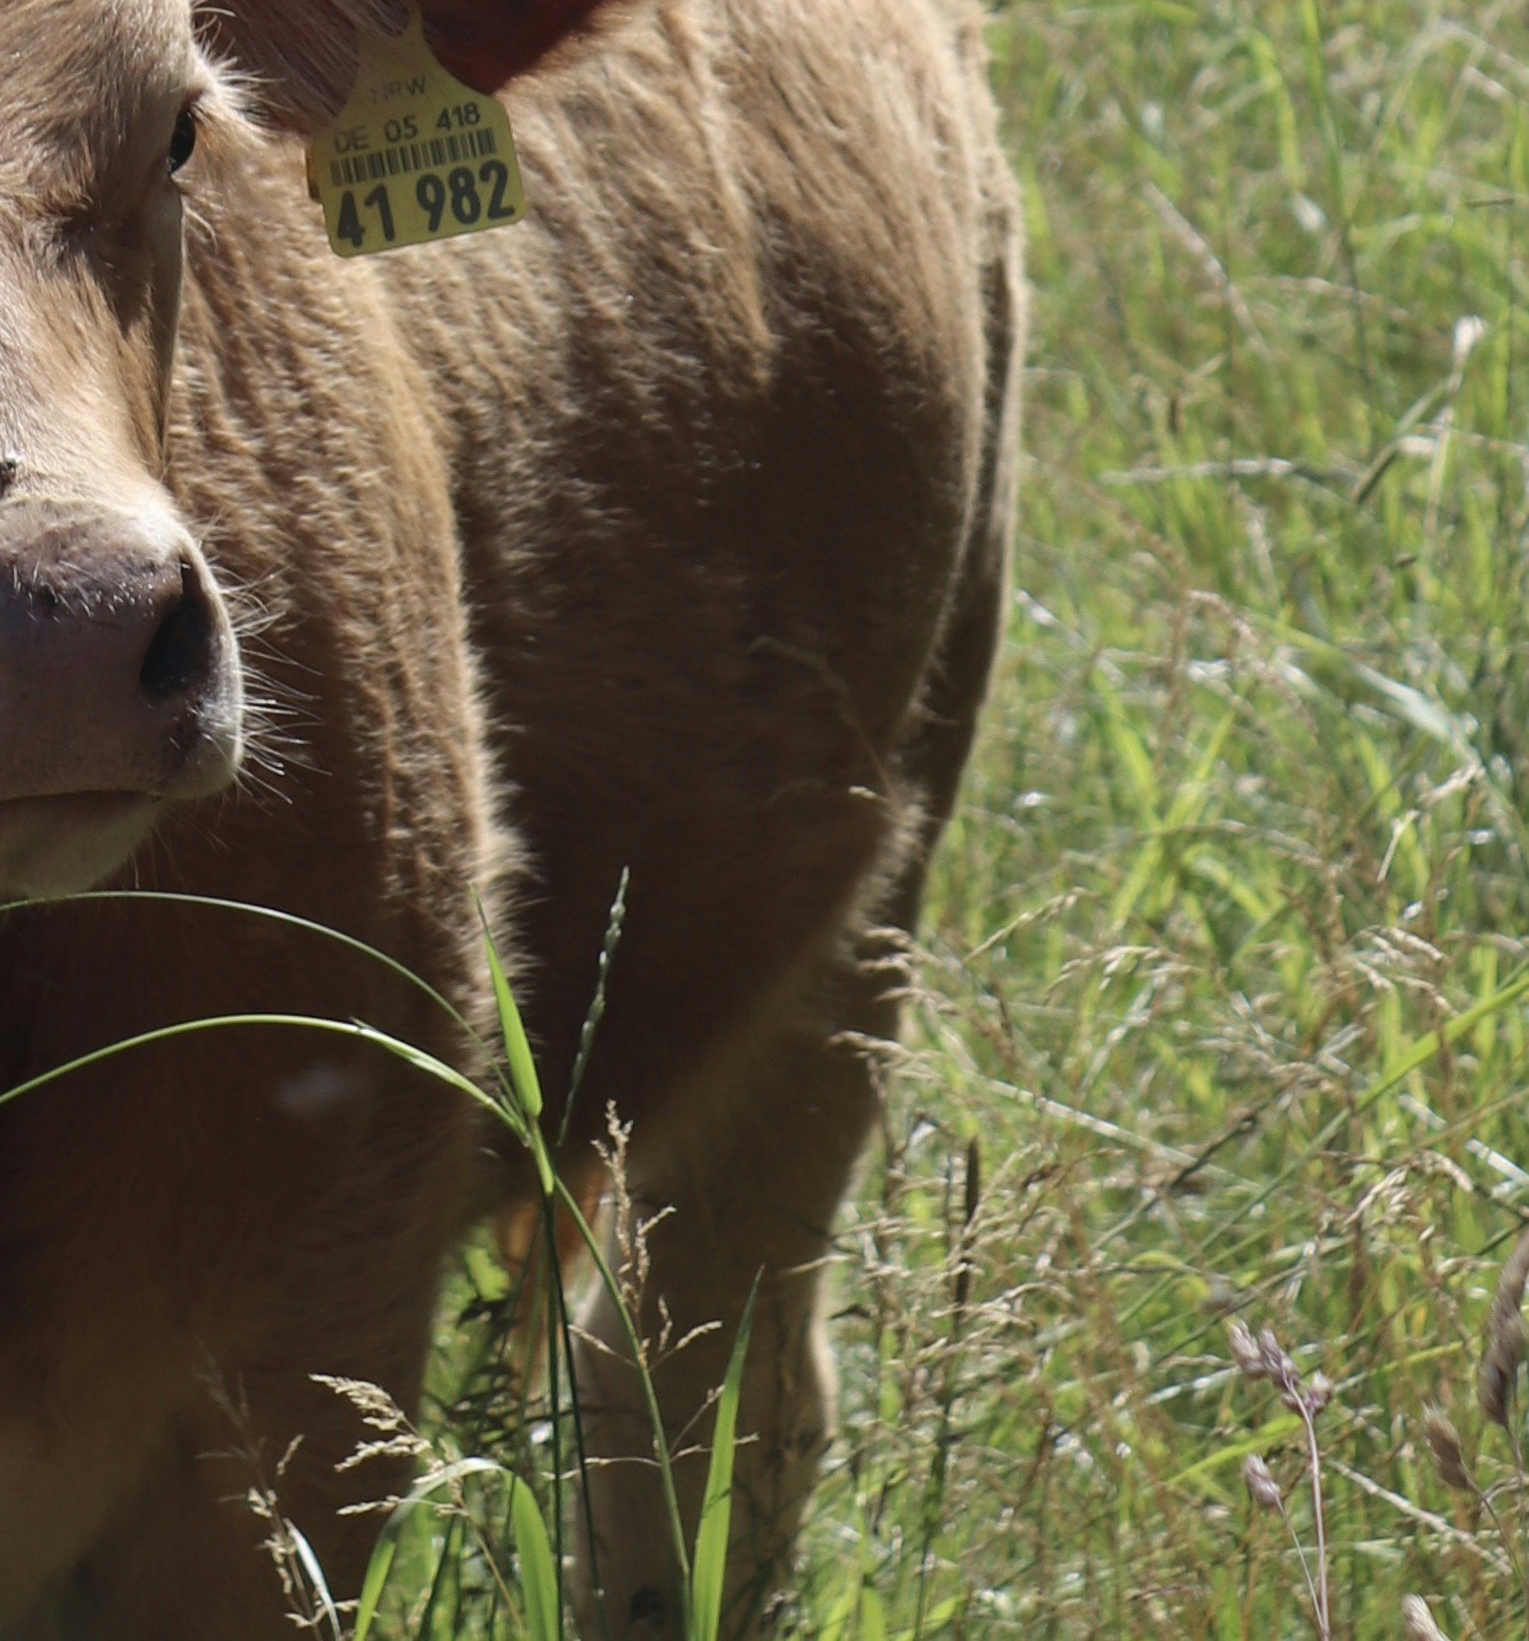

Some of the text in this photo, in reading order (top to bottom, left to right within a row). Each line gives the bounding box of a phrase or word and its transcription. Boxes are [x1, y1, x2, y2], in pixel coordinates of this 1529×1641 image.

[334, 102, 481, 153] DE 05 418
[337, 160, 516, 248] 41 982
